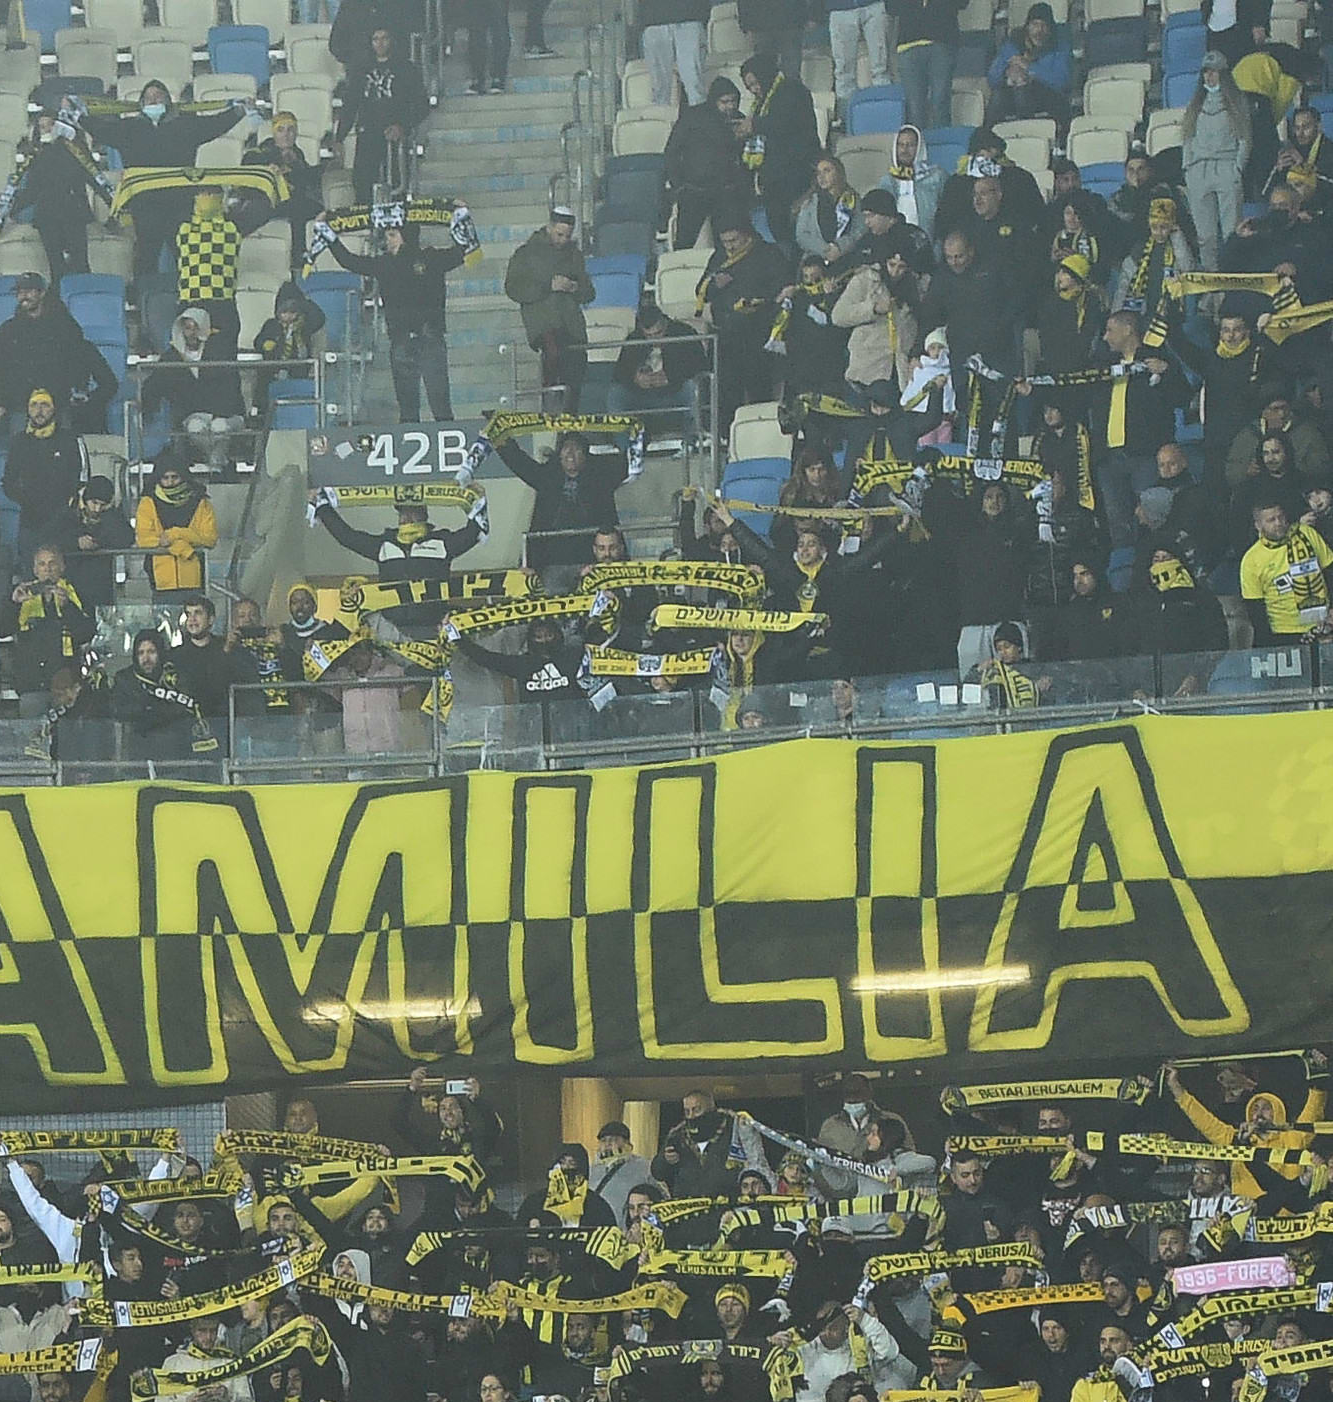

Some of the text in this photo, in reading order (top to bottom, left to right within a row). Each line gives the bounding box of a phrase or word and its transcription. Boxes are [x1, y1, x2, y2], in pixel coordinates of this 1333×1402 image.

[367, 430, 468, 474] 42B
[339, 486, 393, 497] ירושלים
[471, 598, 575, 624] ירושלים
[676, 608, 738, 622] ירושלים
[1251, 648, 1300, 677] HU
[527, 678, 568, 690] adidas
[980, 1081, 1103, 1097] BEITAR JERUSALEM
[34, 1130, 150, 1147] ירושלים
[1257, 1216, 1313, 1234] ירושלים
[676, 1266, 735, 1275] JERUSALEM
[870, 1254, 931, 1277] ירושלים
[630, 1345, 680, 1360] ירושלים
